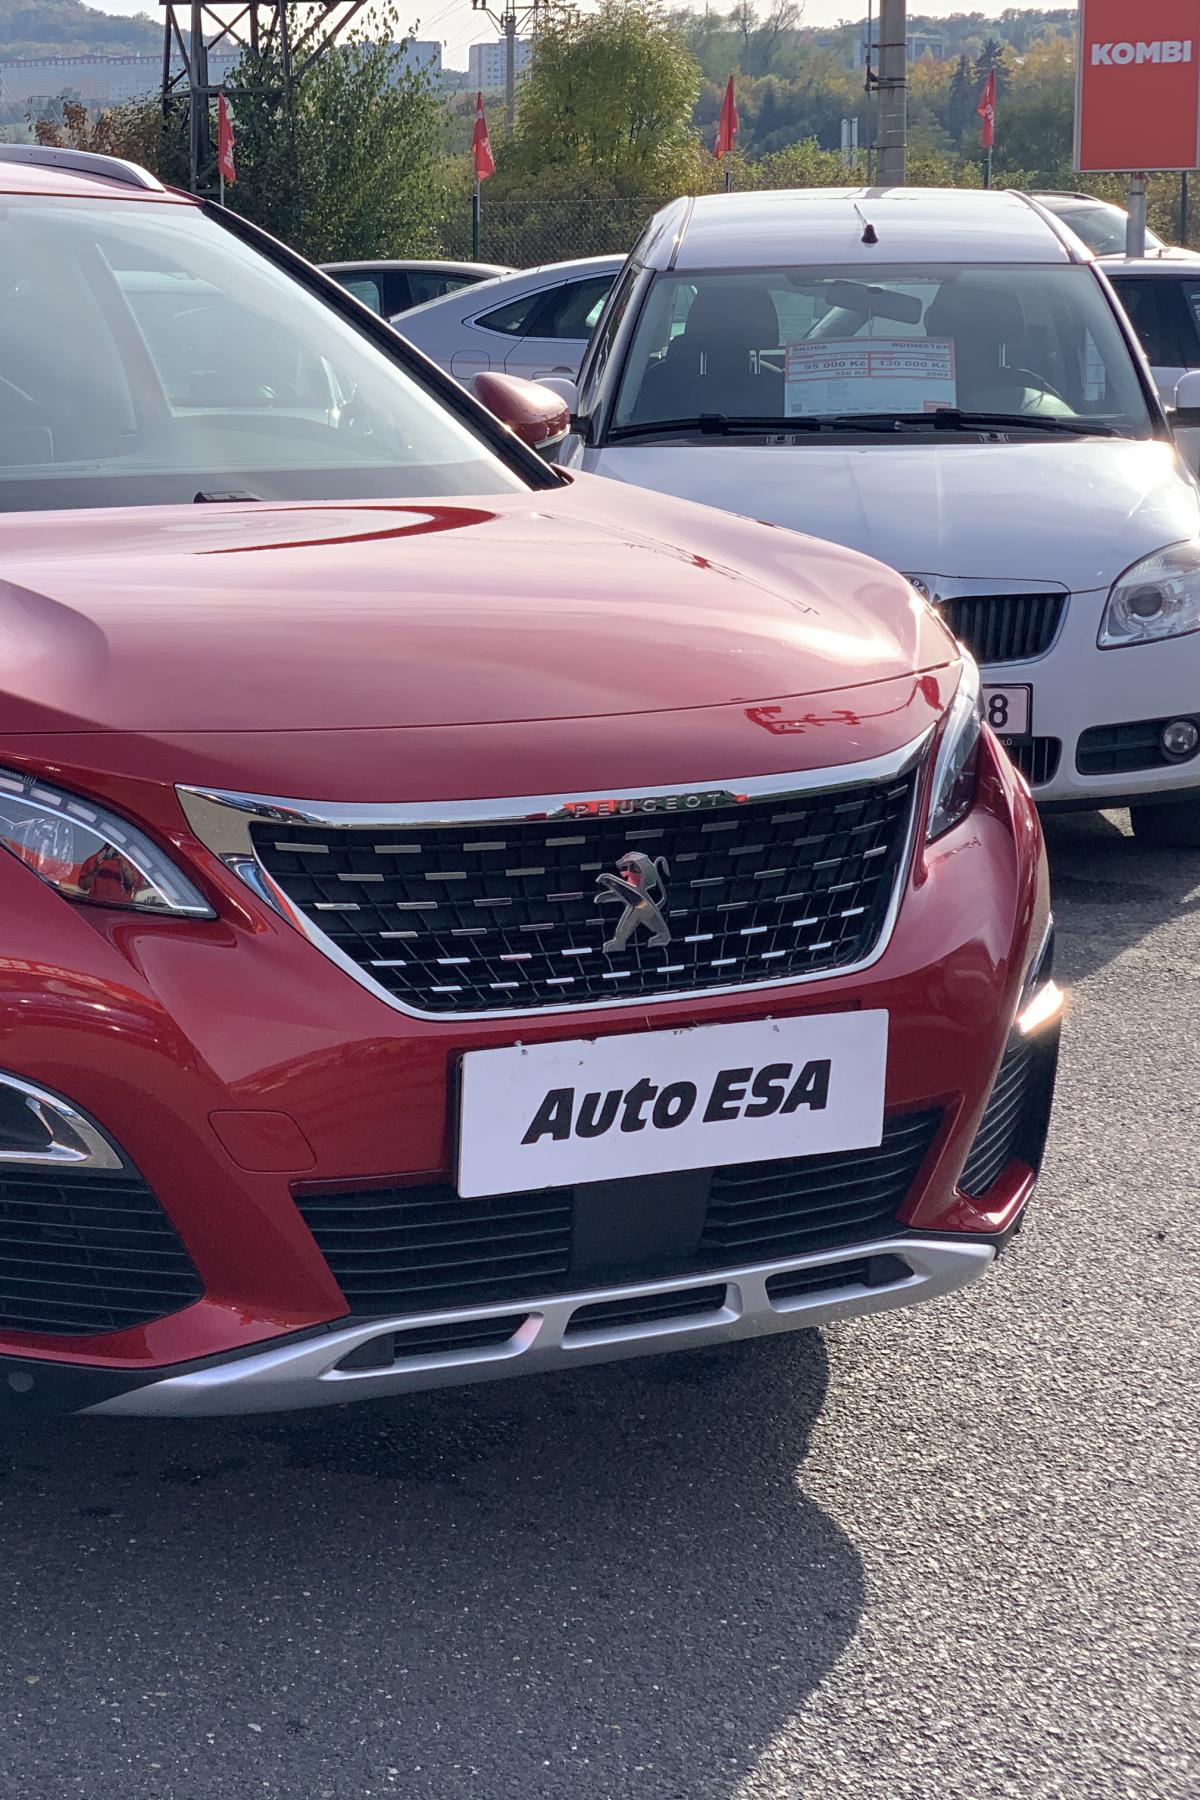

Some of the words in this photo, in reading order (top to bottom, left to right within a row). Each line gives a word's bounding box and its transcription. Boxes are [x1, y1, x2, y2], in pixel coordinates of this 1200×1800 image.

[1091, 40, 1192, 66] KOMBI
[891, 342, 950, 350] ROOMSTER
[823, 361, 846, 369] 000
[904, 360, 928, 368] 000
[574, 793, 721, 818] PEUGEOT
[520, 1077, 698, 1146] Auto
[702, 1059, 832, 1124] ESA
